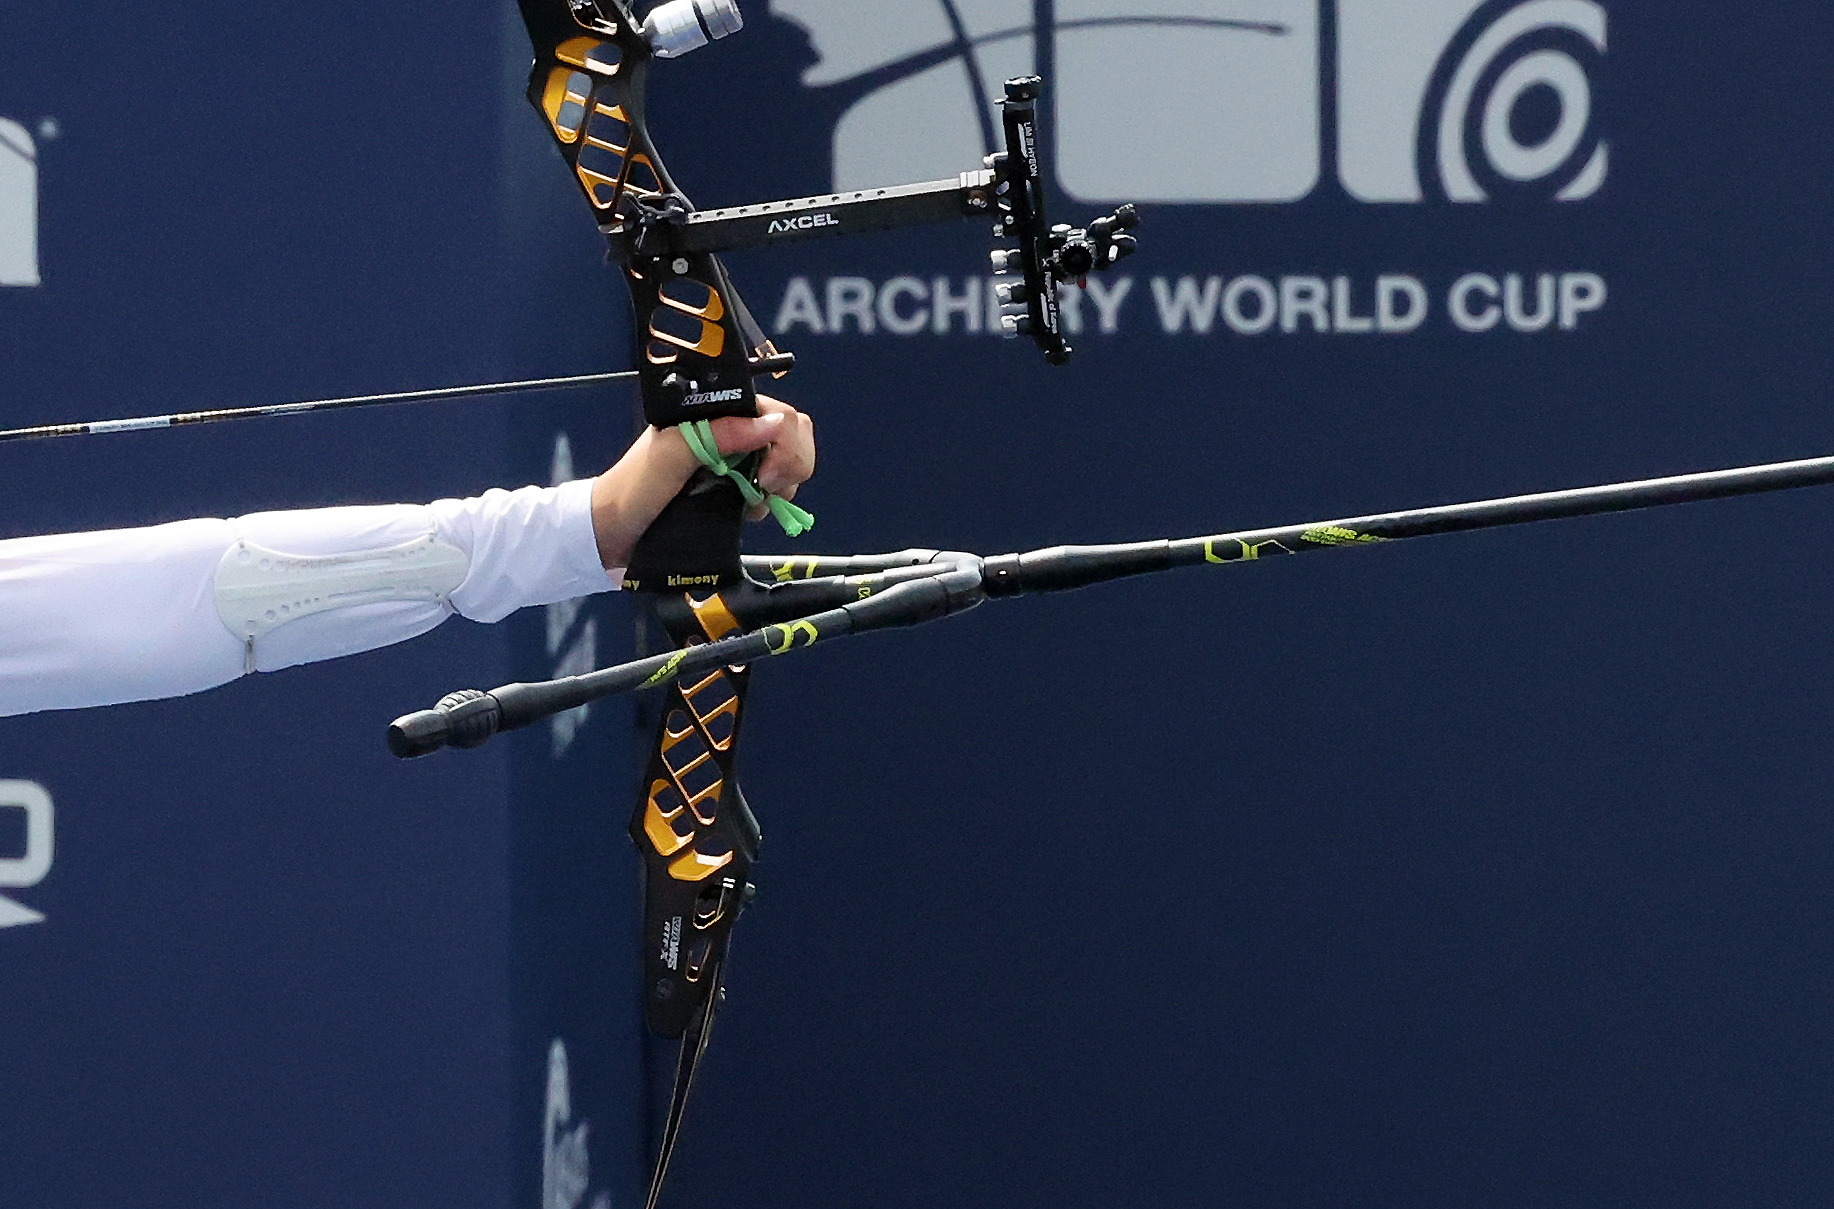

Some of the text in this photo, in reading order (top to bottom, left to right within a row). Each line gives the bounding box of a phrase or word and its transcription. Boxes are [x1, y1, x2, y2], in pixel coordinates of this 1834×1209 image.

[767, 213, 839, 234] AXCEL
[1151, 274, 1428, 335] WORLD
[1447, 272, 1608, 333] CUP
[667, 574, 719, 587] kimony
